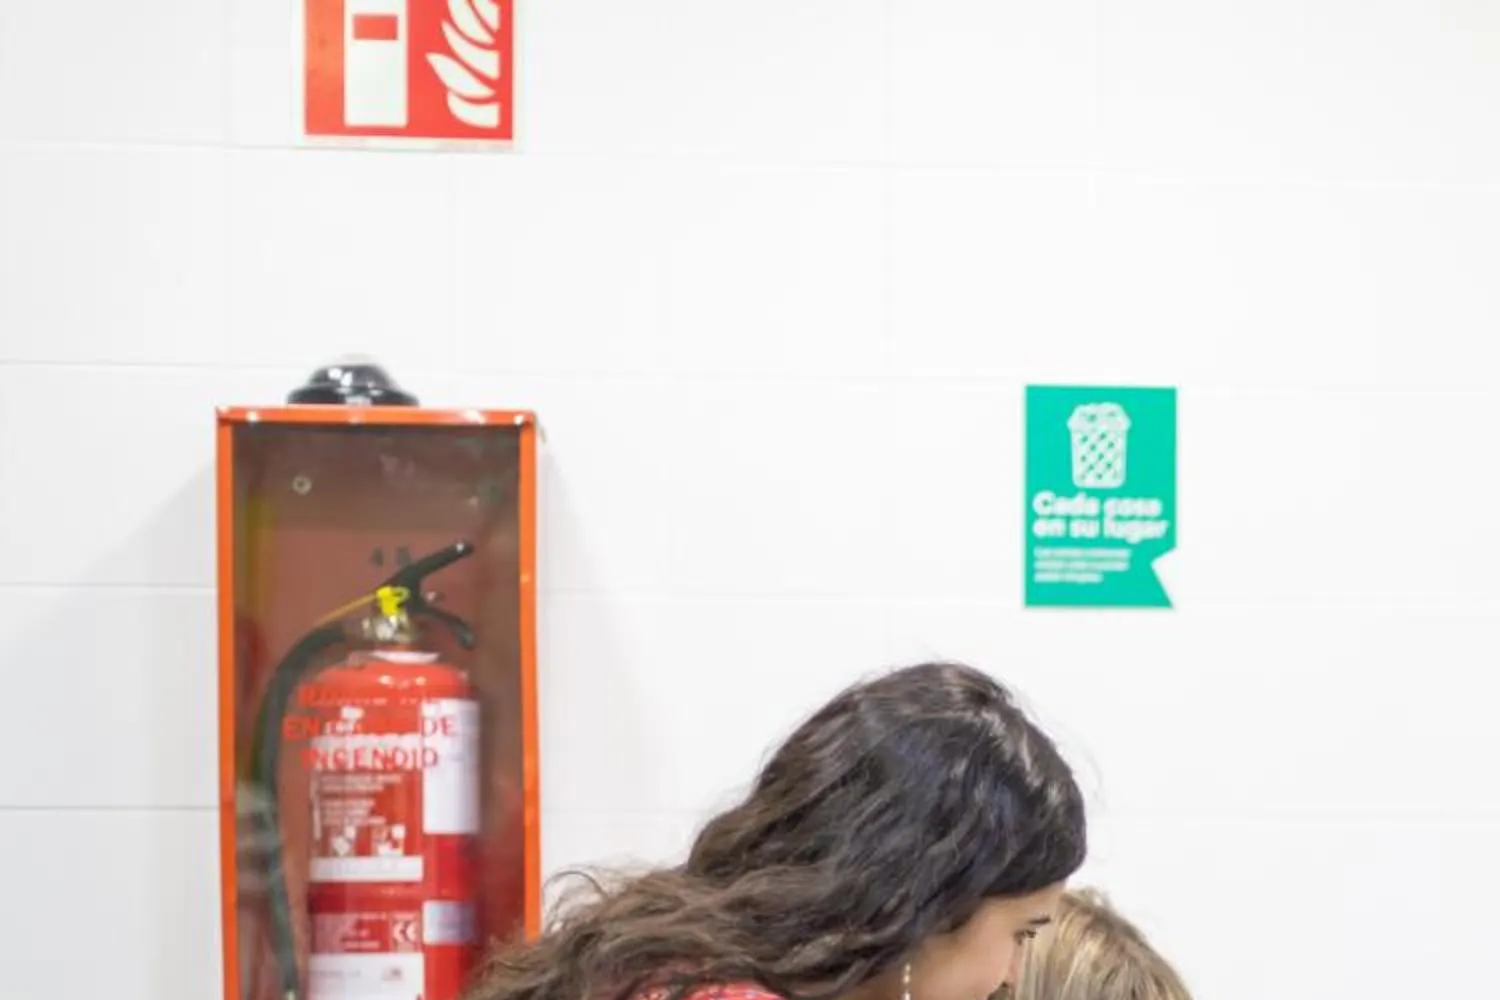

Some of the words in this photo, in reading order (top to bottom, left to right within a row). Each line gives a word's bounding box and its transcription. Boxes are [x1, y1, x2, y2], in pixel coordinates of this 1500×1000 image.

[1033, 491, 1099, 516] Cada
[1033, 519, 1066, 538] en
[1070, 519, 1099, 538] su
[1103, 515, 1168, 544] lugar
[420, 716, 457, 738] DE
